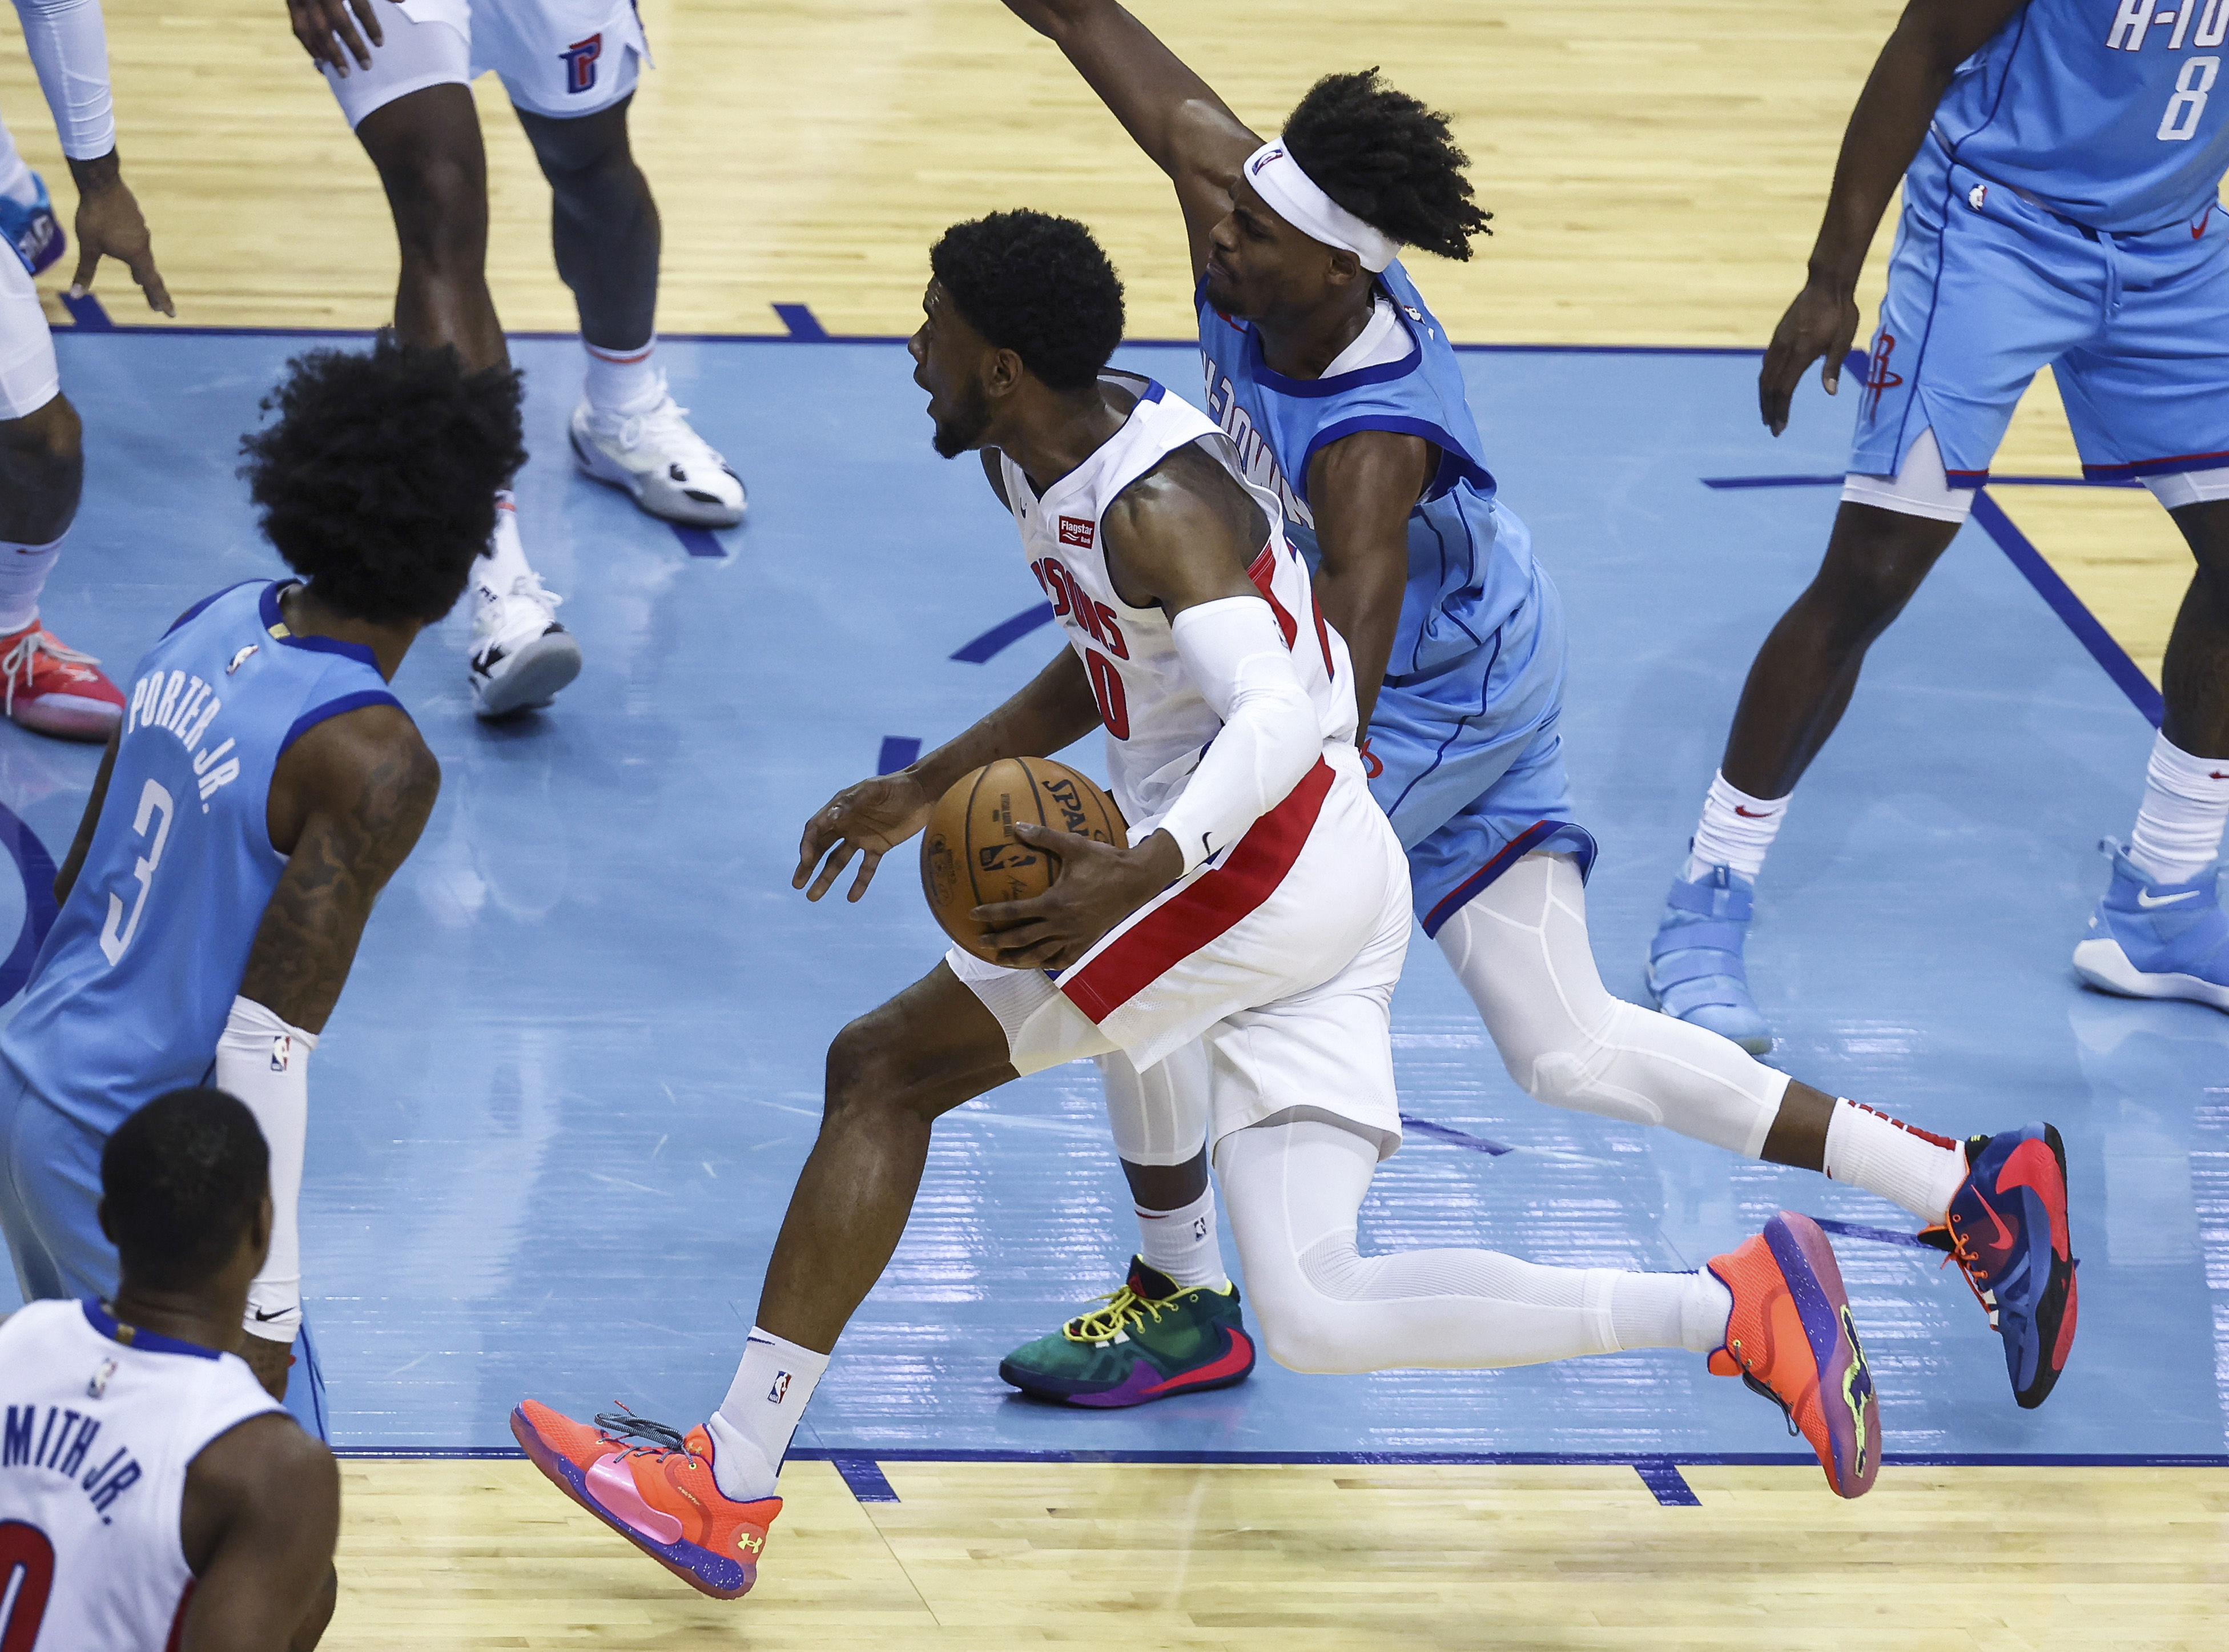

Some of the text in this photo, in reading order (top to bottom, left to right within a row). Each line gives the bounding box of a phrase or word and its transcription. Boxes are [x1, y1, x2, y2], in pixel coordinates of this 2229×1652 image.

[2156, 55, 2222, 141] 8
[1061, 520, 1093, 535] Flagstar
[128, 669, 240, 814] PORTER JR.
[99, 778, 175, 967] 3
[82, 1445, 143, 1526] JR.
